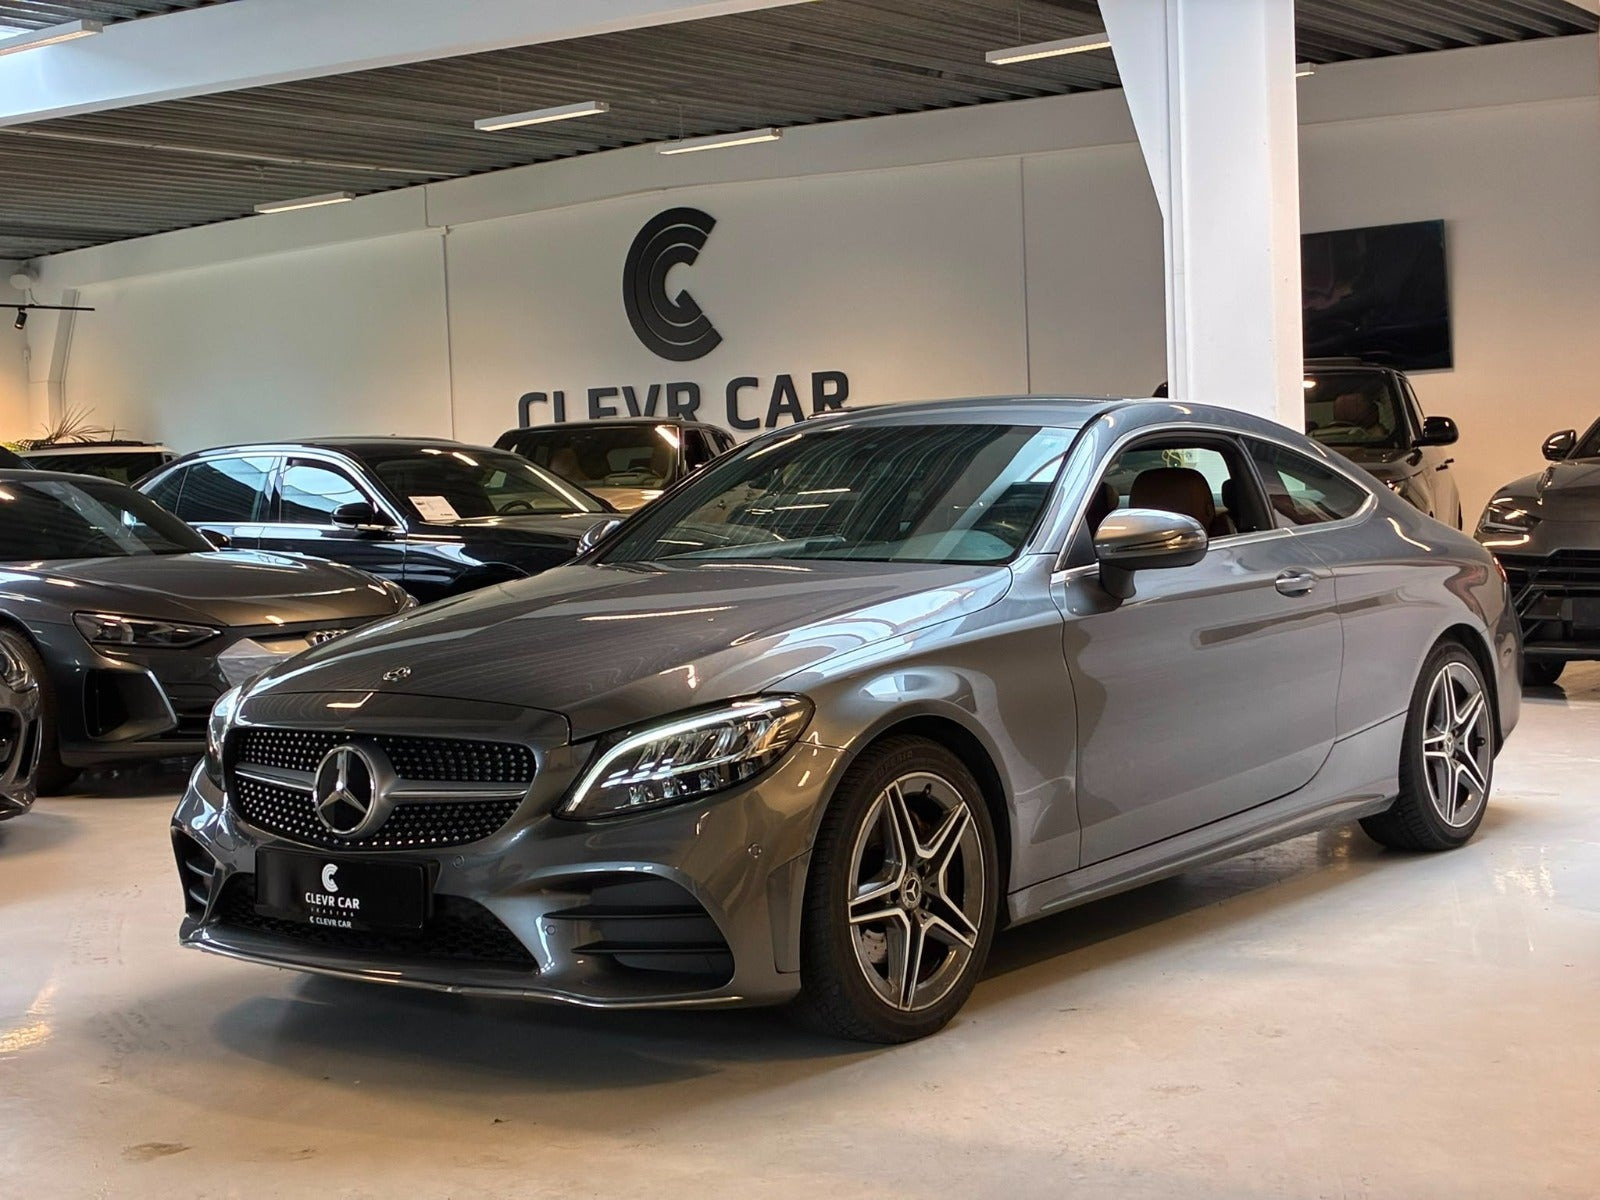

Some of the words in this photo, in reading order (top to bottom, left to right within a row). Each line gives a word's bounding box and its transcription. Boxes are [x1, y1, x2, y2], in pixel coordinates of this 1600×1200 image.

[726, 371, 849, 430] CAR
[305, 892, 335, 907] CLEVR
[337, 897, 360, 909] CAR
[316, 917, 336, 926] CLEVR
[337, 919, 352, 928] CAR
